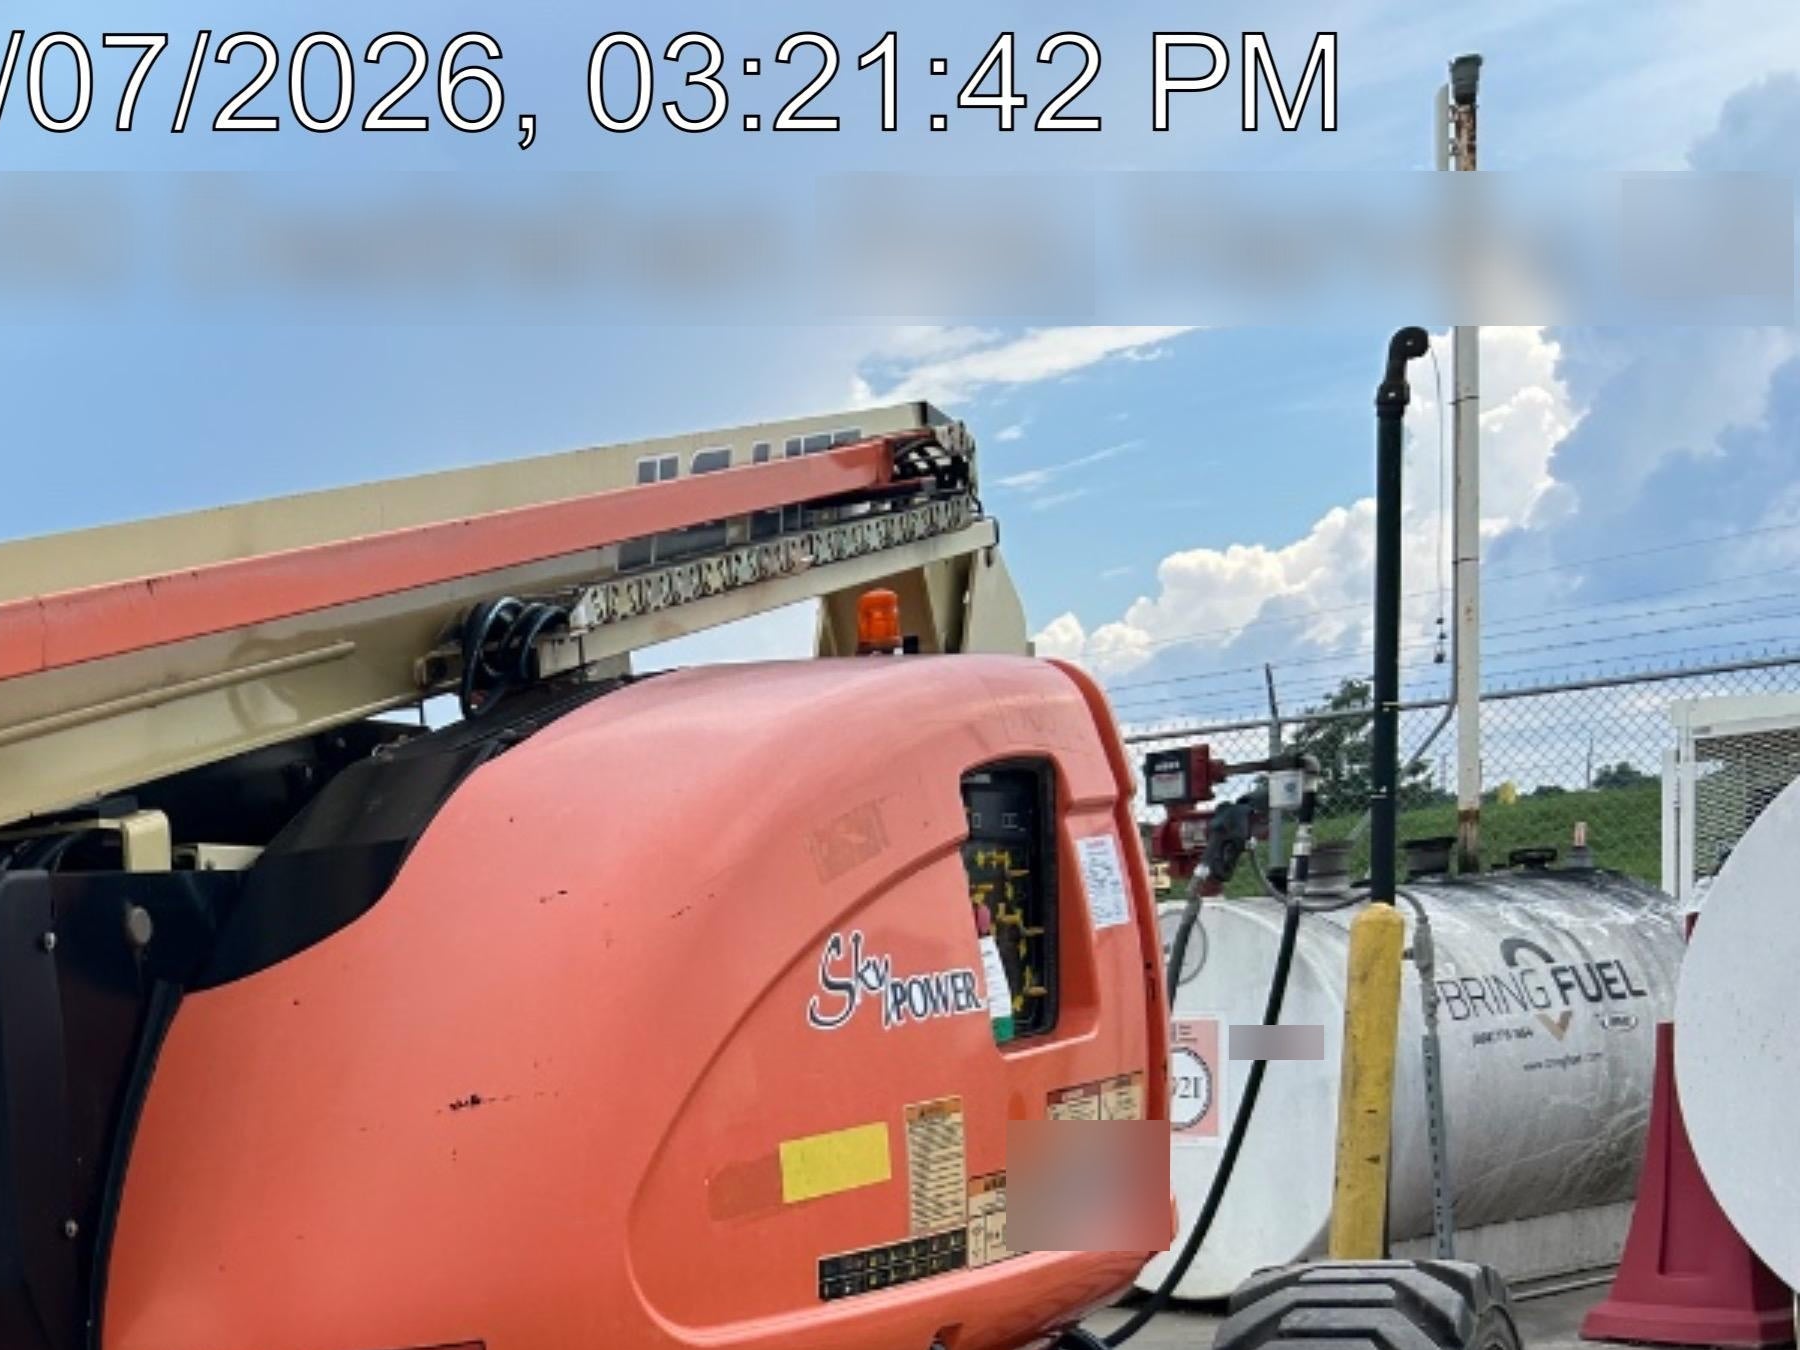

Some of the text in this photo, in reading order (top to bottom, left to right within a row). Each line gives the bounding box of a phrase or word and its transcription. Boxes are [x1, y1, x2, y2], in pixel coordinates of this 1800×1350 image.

[808, 930, 891, 1030] Sky
[885, 968, 988, 1028] POWER
[1436, 960, 1647, 1021] BRING FUEL
